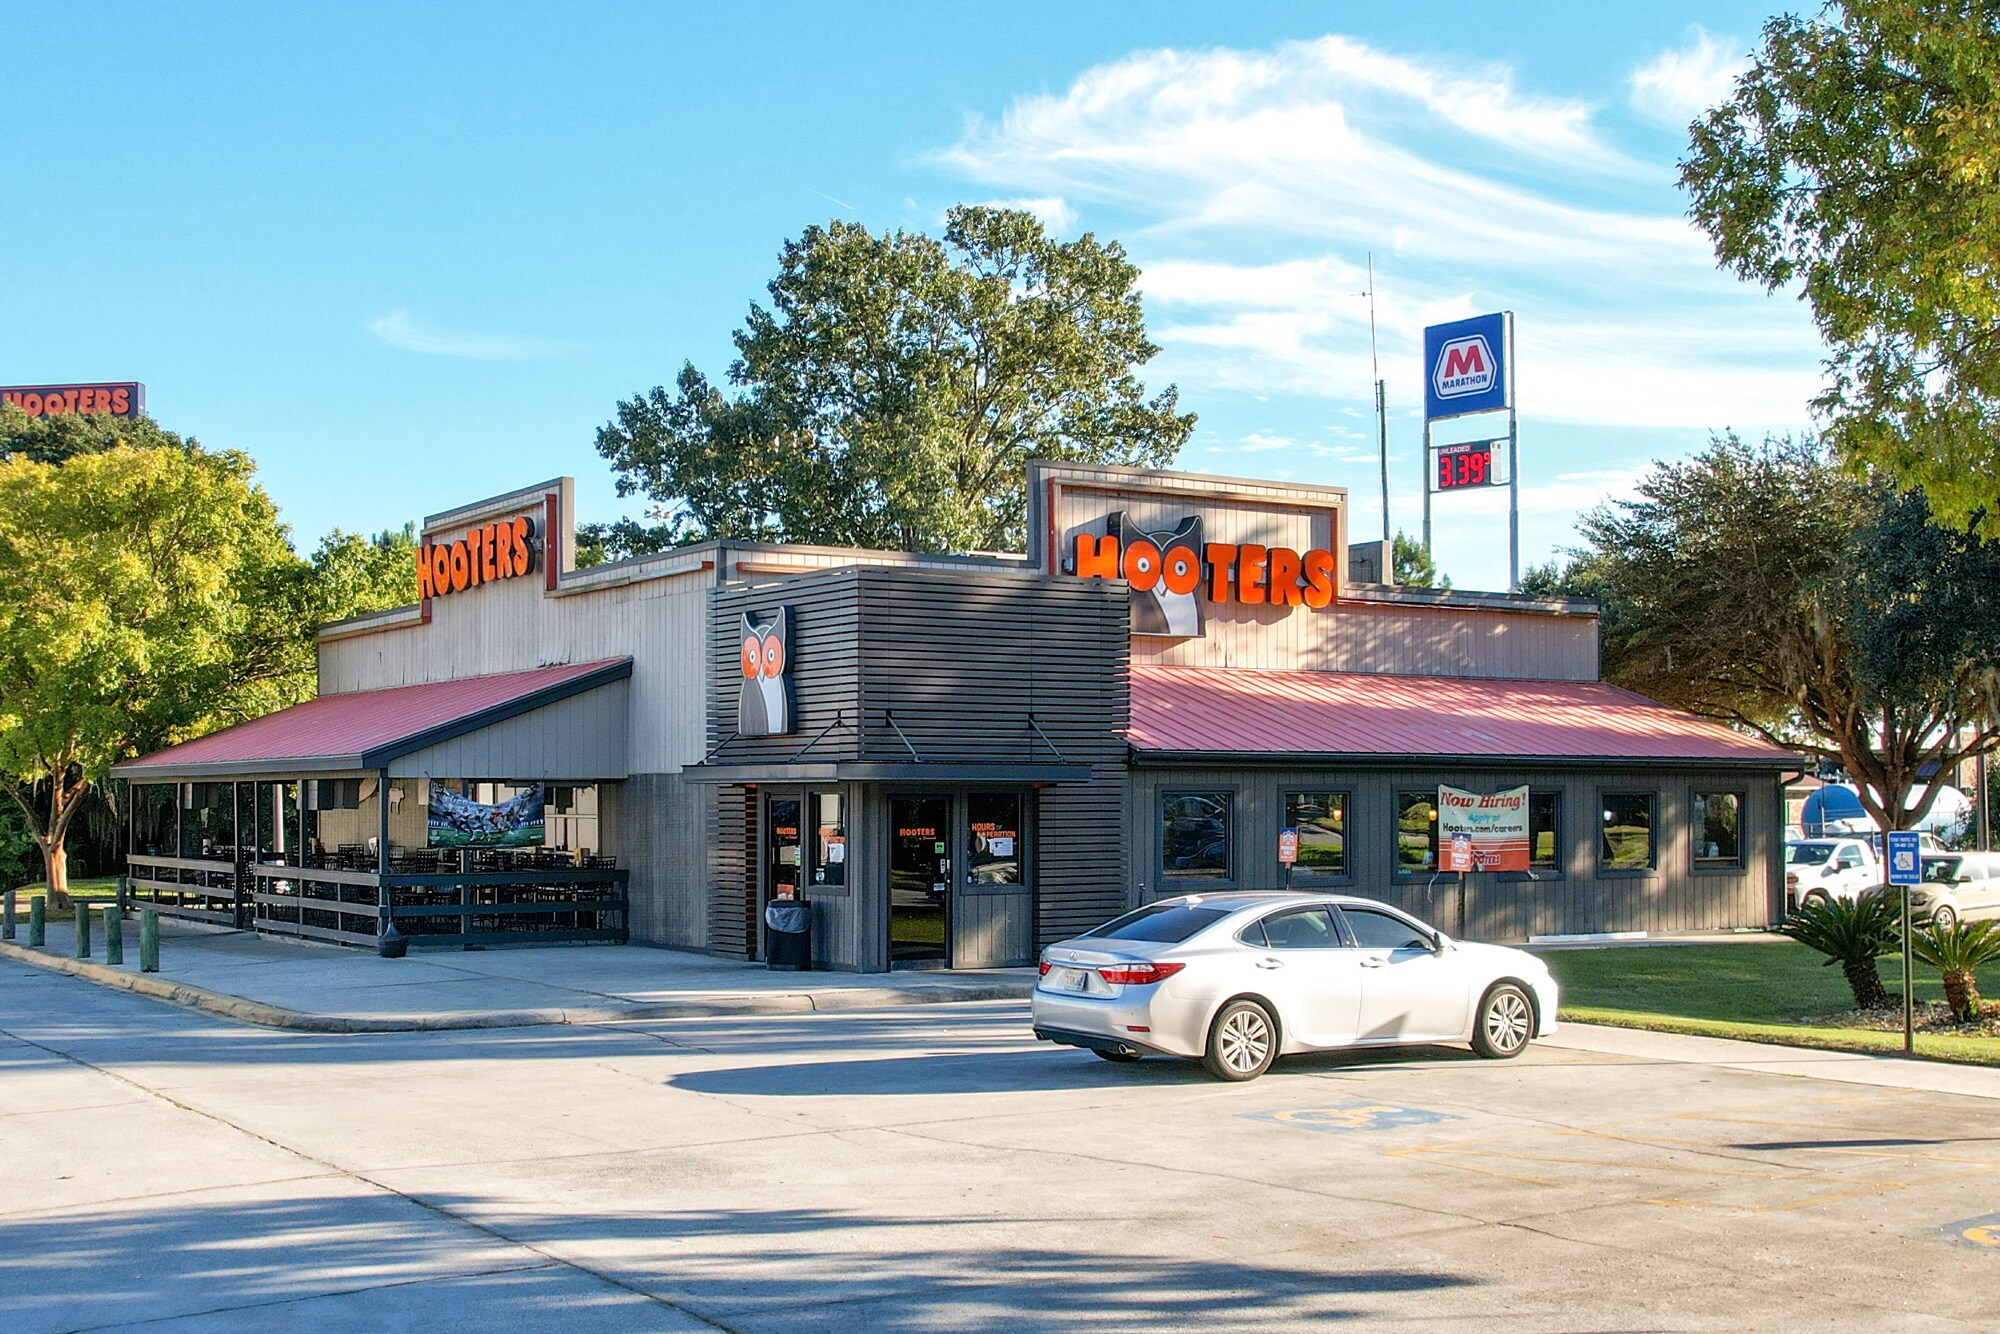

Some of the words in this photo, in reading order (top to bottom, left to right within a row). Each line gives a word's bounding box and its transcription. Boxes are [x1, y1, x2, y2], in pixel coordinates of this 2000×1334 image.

[1441, 374, 1487, 389] MARATHON
[1439, 445, 1470, 455] UNLEADED
[416, 516, 535, 600] HOOTERS
[1074, 533, 1334, 608] HOOTERS
[1440, 792, 1475, 808] Now
[1478, 793, 1526, 811] Hiring!
[899, 828, 935, 836] HOOTERS
[971, 822, 996, 831] HOURS
